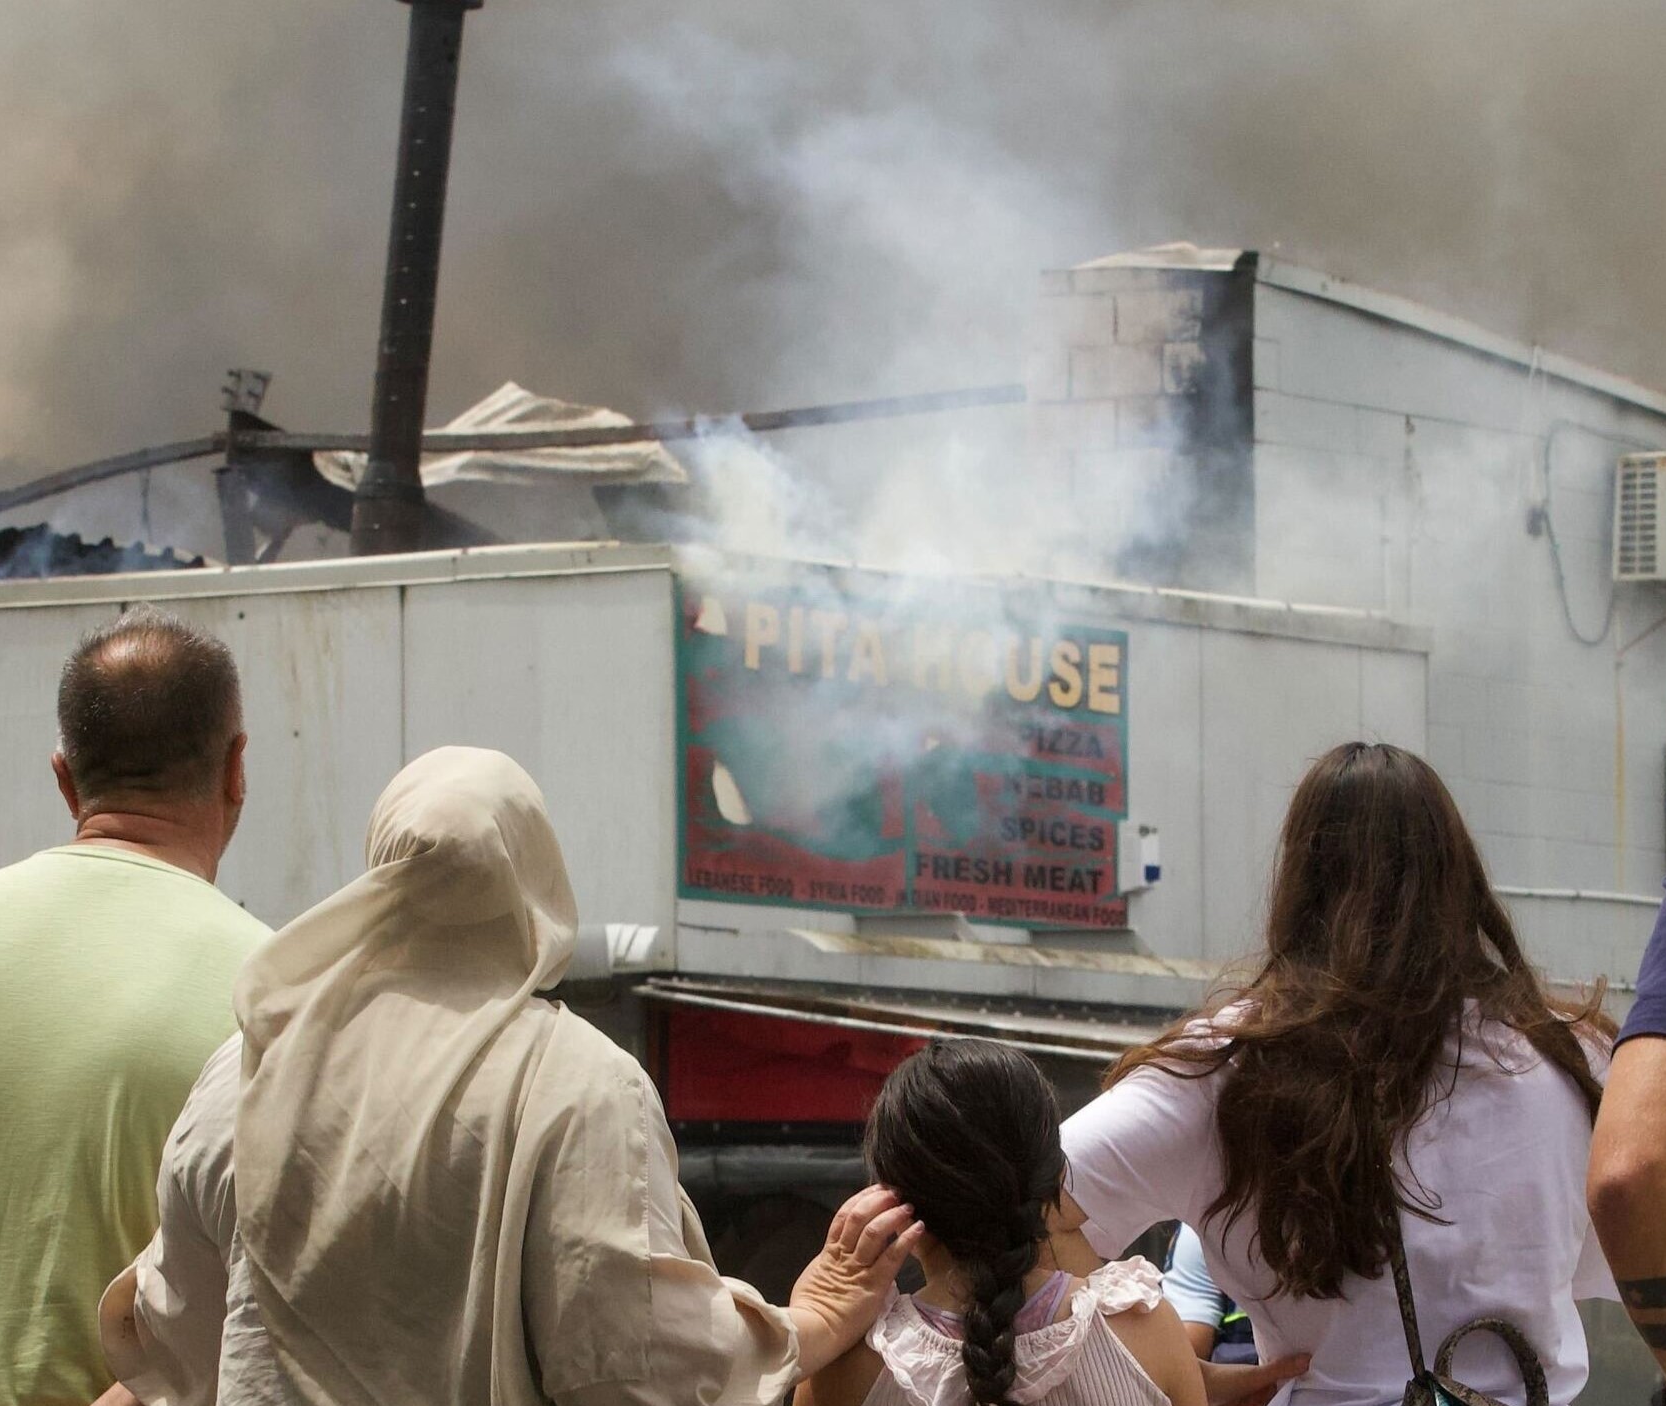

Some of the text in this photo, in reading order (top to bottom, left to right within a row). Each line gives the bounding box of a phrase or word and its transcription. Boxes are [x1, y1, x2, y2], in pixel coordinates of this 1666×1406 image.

[744, 603, 1121, 715] PITA HOUSE
[1000, 816, 1105, 852] SPICES
[915, 852, 1105, 896] FRESH MEAT
[760, 875, 793, 898] FOOD
[809, 880, 846, 900] SYRIA
[853, 883, 885, 905] FOOD
[943, 892, 976, 912] FOOD
[987, 897, 1090, 921] MEDITERRANEAN
[1094, 905, 1126, 927] FOOD
